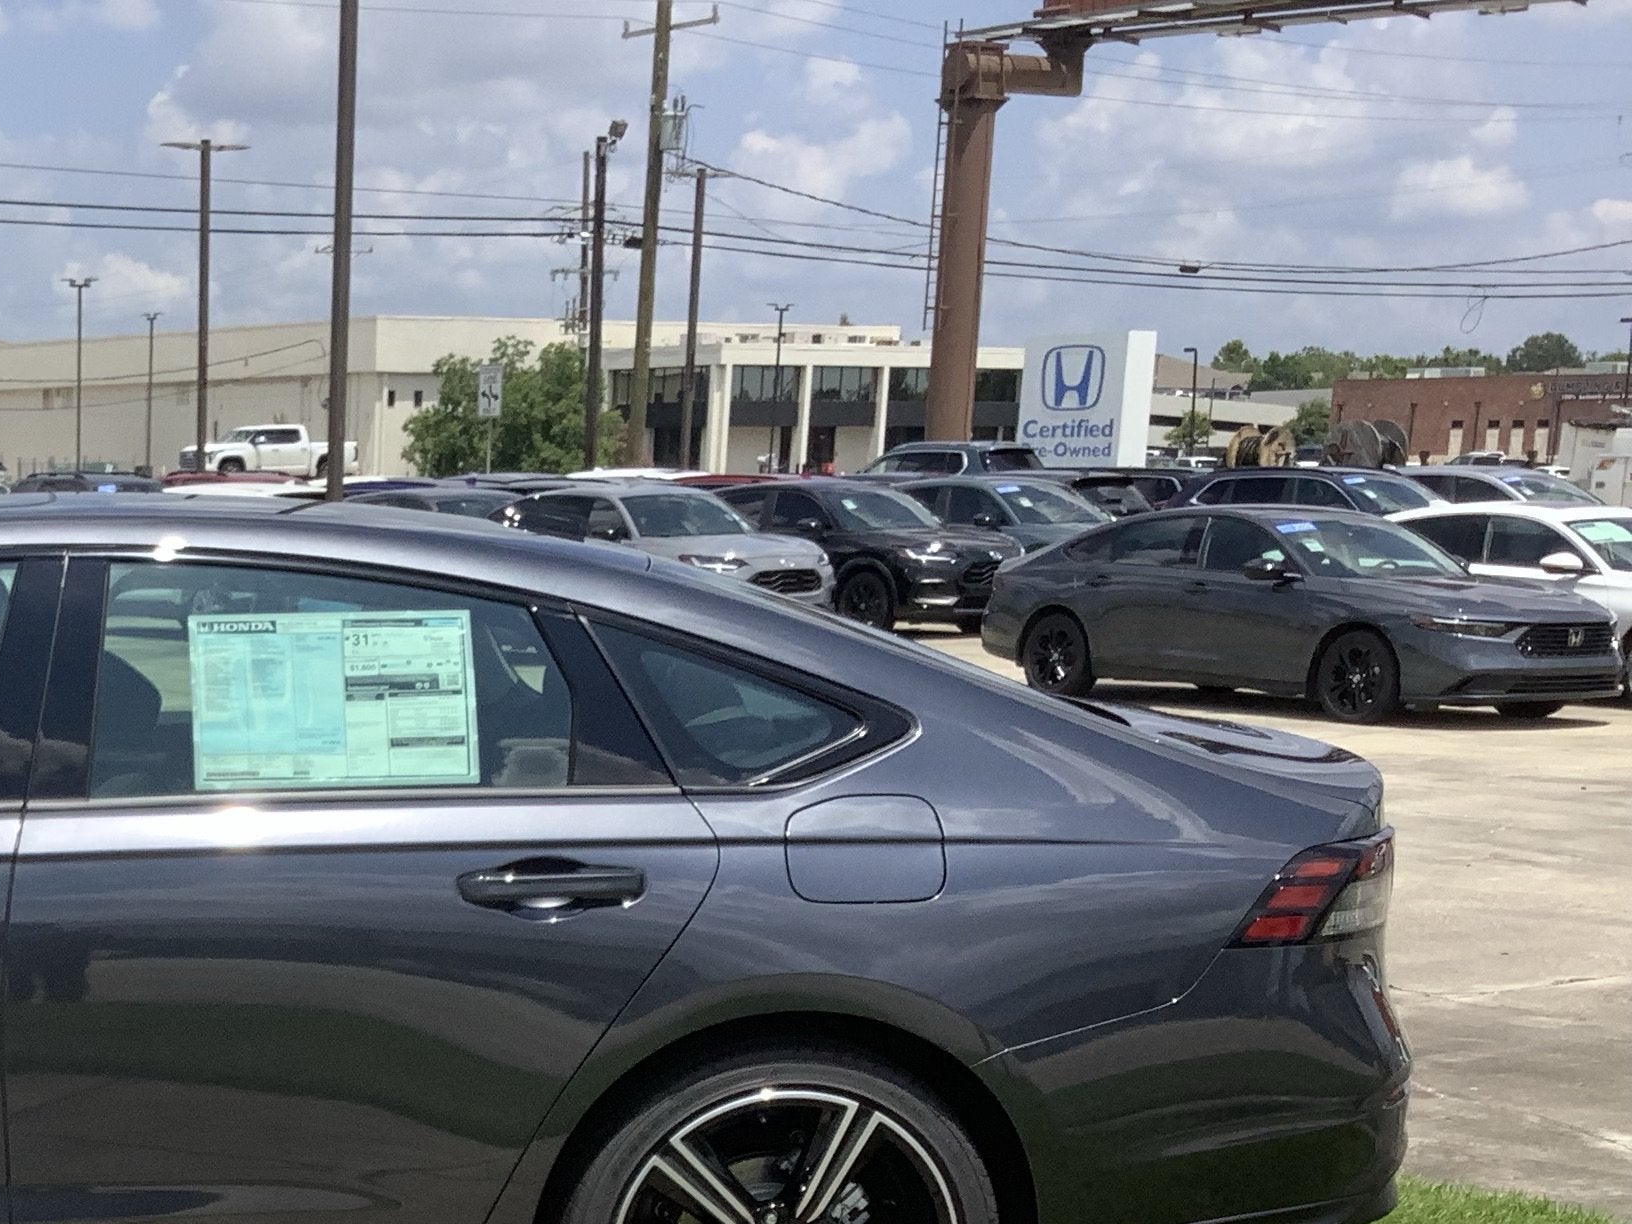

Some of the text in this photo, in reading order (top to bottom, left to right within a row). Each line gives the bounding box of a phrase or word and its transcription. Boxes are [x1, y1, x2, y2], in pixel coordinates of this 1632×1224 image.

[1023, 418, 1115, 439] Certified
[212, 622, 274, 632] HONDA
[352, 633, 369, 646] 31
